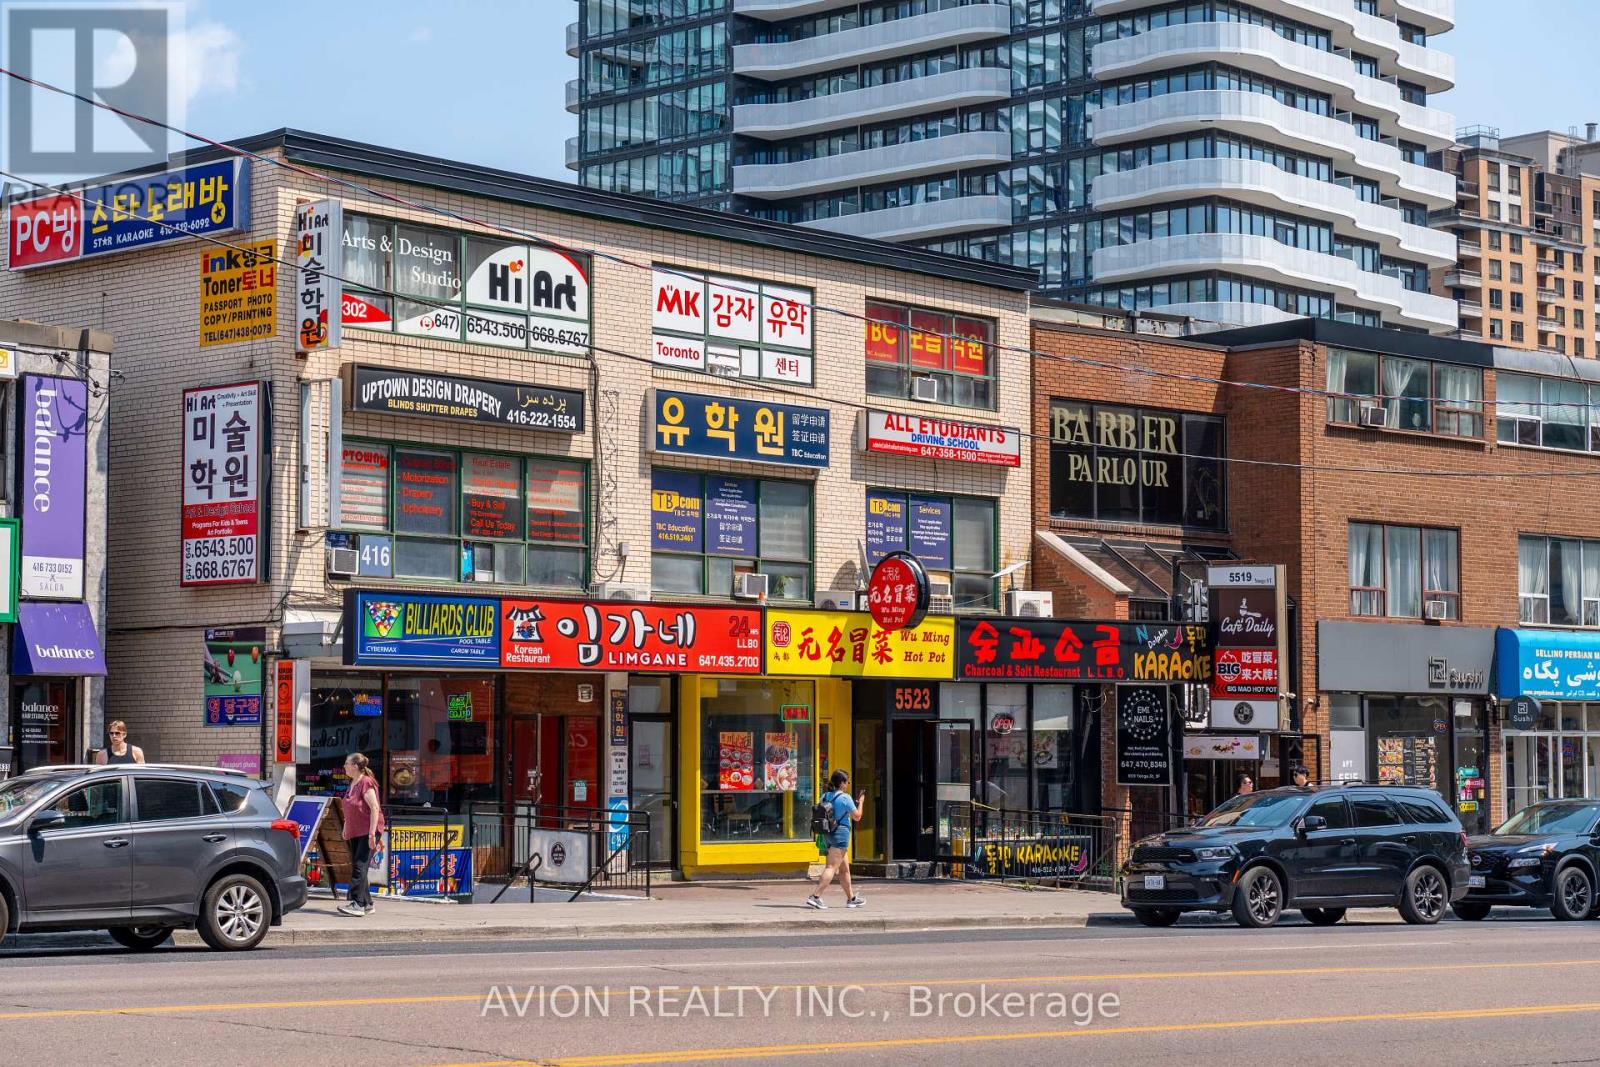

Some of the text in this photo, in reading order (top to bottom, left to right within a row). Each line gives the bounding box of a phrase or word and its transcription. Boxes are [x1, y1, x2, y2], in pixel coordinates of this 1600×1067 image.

[149, 175, 229, 225] 노래방
[16, 207, 77, 256] PC방
[116, 228, 154, 245] KARAOKE
[341, 231, 453, 266] Arts & Design
[411, 267, 461, 290] Studio
[489, 262, 577, 312] Hi Art
[204, 293, 273, 313] PASSPORT PHOTO
[342, 302, 367, 318] 302
[657, 285, 807, 338] MK 감자 유학
[204, 308, 273, 326] COPY/PRINTING
[467, 321, 525, 341] 6543.500
[532, 326, 588, 347] 668.6767
[656, 342, 700, 360] Toronto
[775, 357, 800, 378] 센터
[362, 378, 502, 418] UPTOWN DESIGN DRAPERY
[388, 399, 478, 417] BLINDS SHUTTER DRAPES
[506, 409, 577, 429] 416-222-1554
[657, 396, 784, 456] 유학원
[193, 411, 250, 453] 미술
[884, 413, 1006, 444] ALL ETUDIANTS
[1052, 407, 1178, 454] BARBER
[34, 388, 58, 512] balance
[911, 433, 981, 450] DRIVING SCHOOL
[920, 446, 977, 462] 647-358-1500
[190, 454, 249, 499] 학원
[1069, 454, 1169, 487] PARLOUR
[919, 505, 941, 515] Services
[668, 523, 696, 533] Education
[361, 544, 390, 567] 416
[32, 562, 45, 573] 416
[45, 562, 57, 574] 733
[1229, 572, 1252, 582] 5519
[39, 582, 65, 592] SALON
[405, 603, 494, 637] BILLIARDS CLUB
[729, 615, 749, 637] 24
[1220, 616, 1275, 637] Café Daily
[556, 604, 696, 666] 임가네
[737, 639, 759, 648] LLBO
[900, 630, 950, 646] Wu Ming
[1147, 628, 1169, 649] Dolphin
[35, 644, 95, 660] balance
[506, 653, 550, 664] Restaurant
[513, 644, 543, 655] Korean
[903, 651, 946, 663] Hot Pot
[1535, 649, 1593, 659] SELLING PERSIAN
[608, 652, 688, 666] LIMGANE
[699, 655, 759, 667] 647.435.2700
[964, 664, 1080, 678] Charcoal & Salt Restaurant
[1217, 663, 1240, 674] BIG
[21, 701, 59, 713] balance
[895, 687, 931, 710] 5523
[1133, 715, 1154, 723] NAILS
[1513, 714, 1533, 722] Sushi
[221, 760, 257, 770] Passport photo
